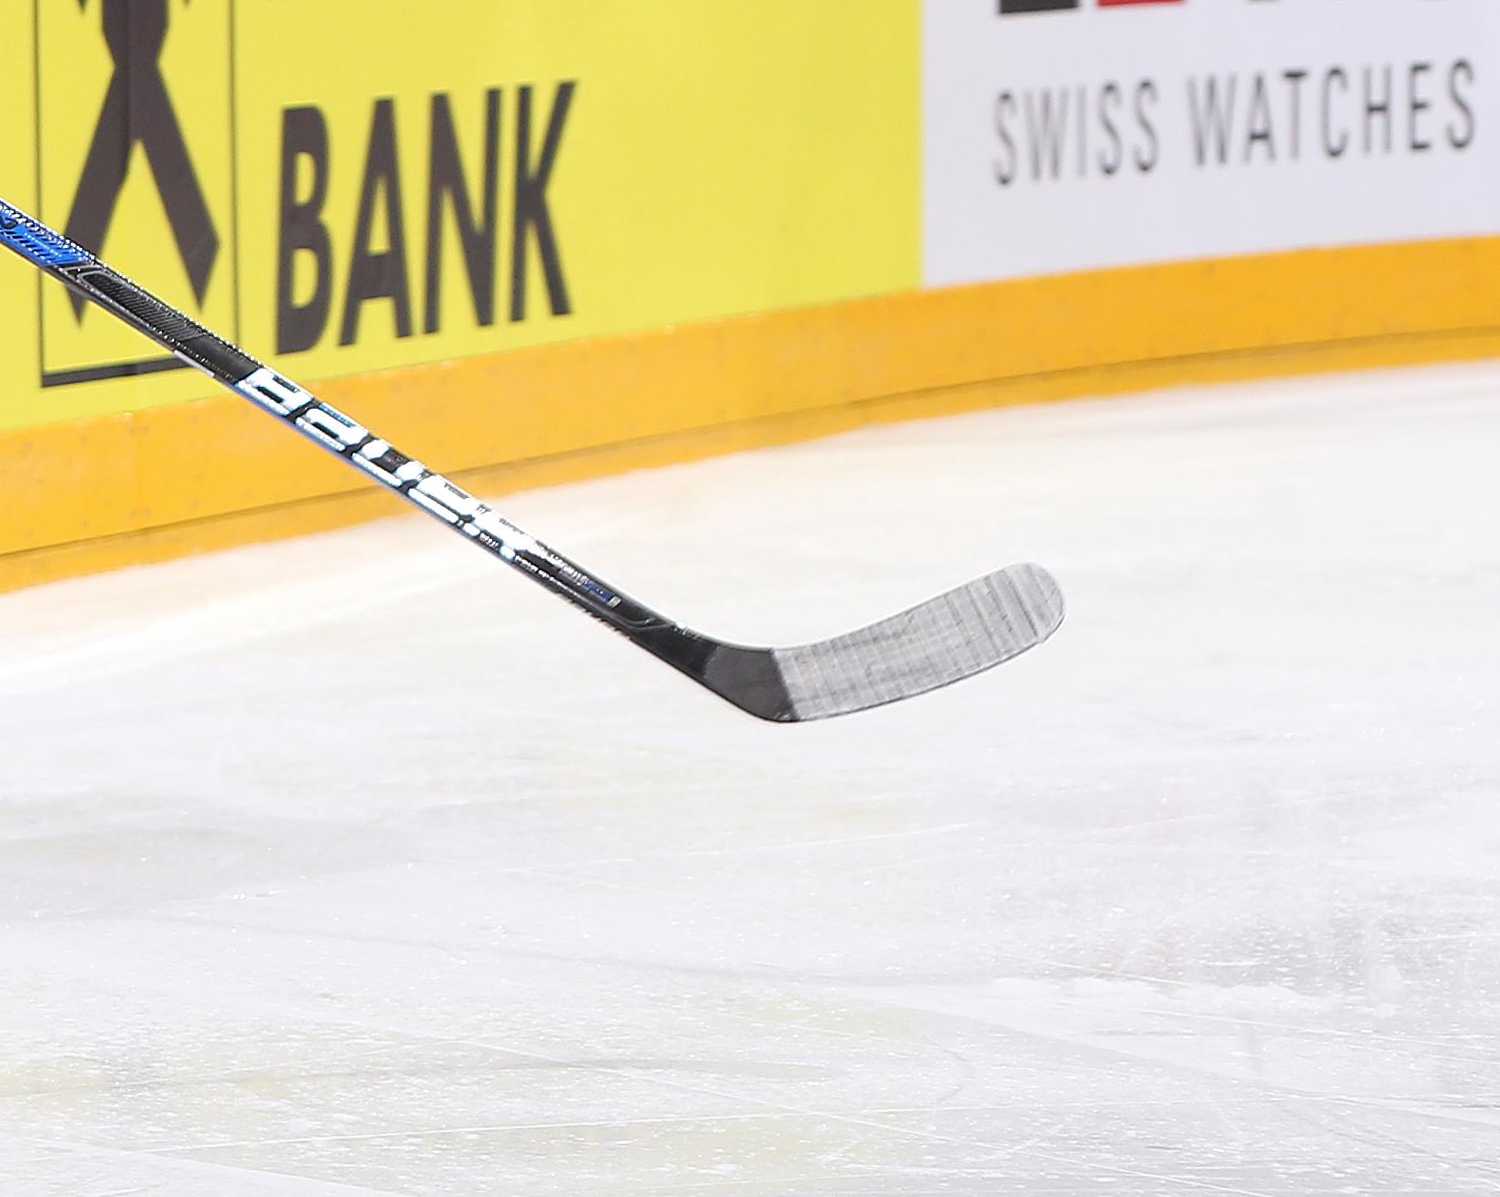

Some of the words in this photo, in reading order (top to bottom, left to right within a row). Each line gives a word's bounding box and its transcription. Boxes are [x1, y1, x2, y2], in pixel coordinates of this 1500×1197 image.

[275, 79, 579, 357] BANK
[992, 90, 1161, 189] SWISS
[1185, 56, 1477, 170] WATCHES
